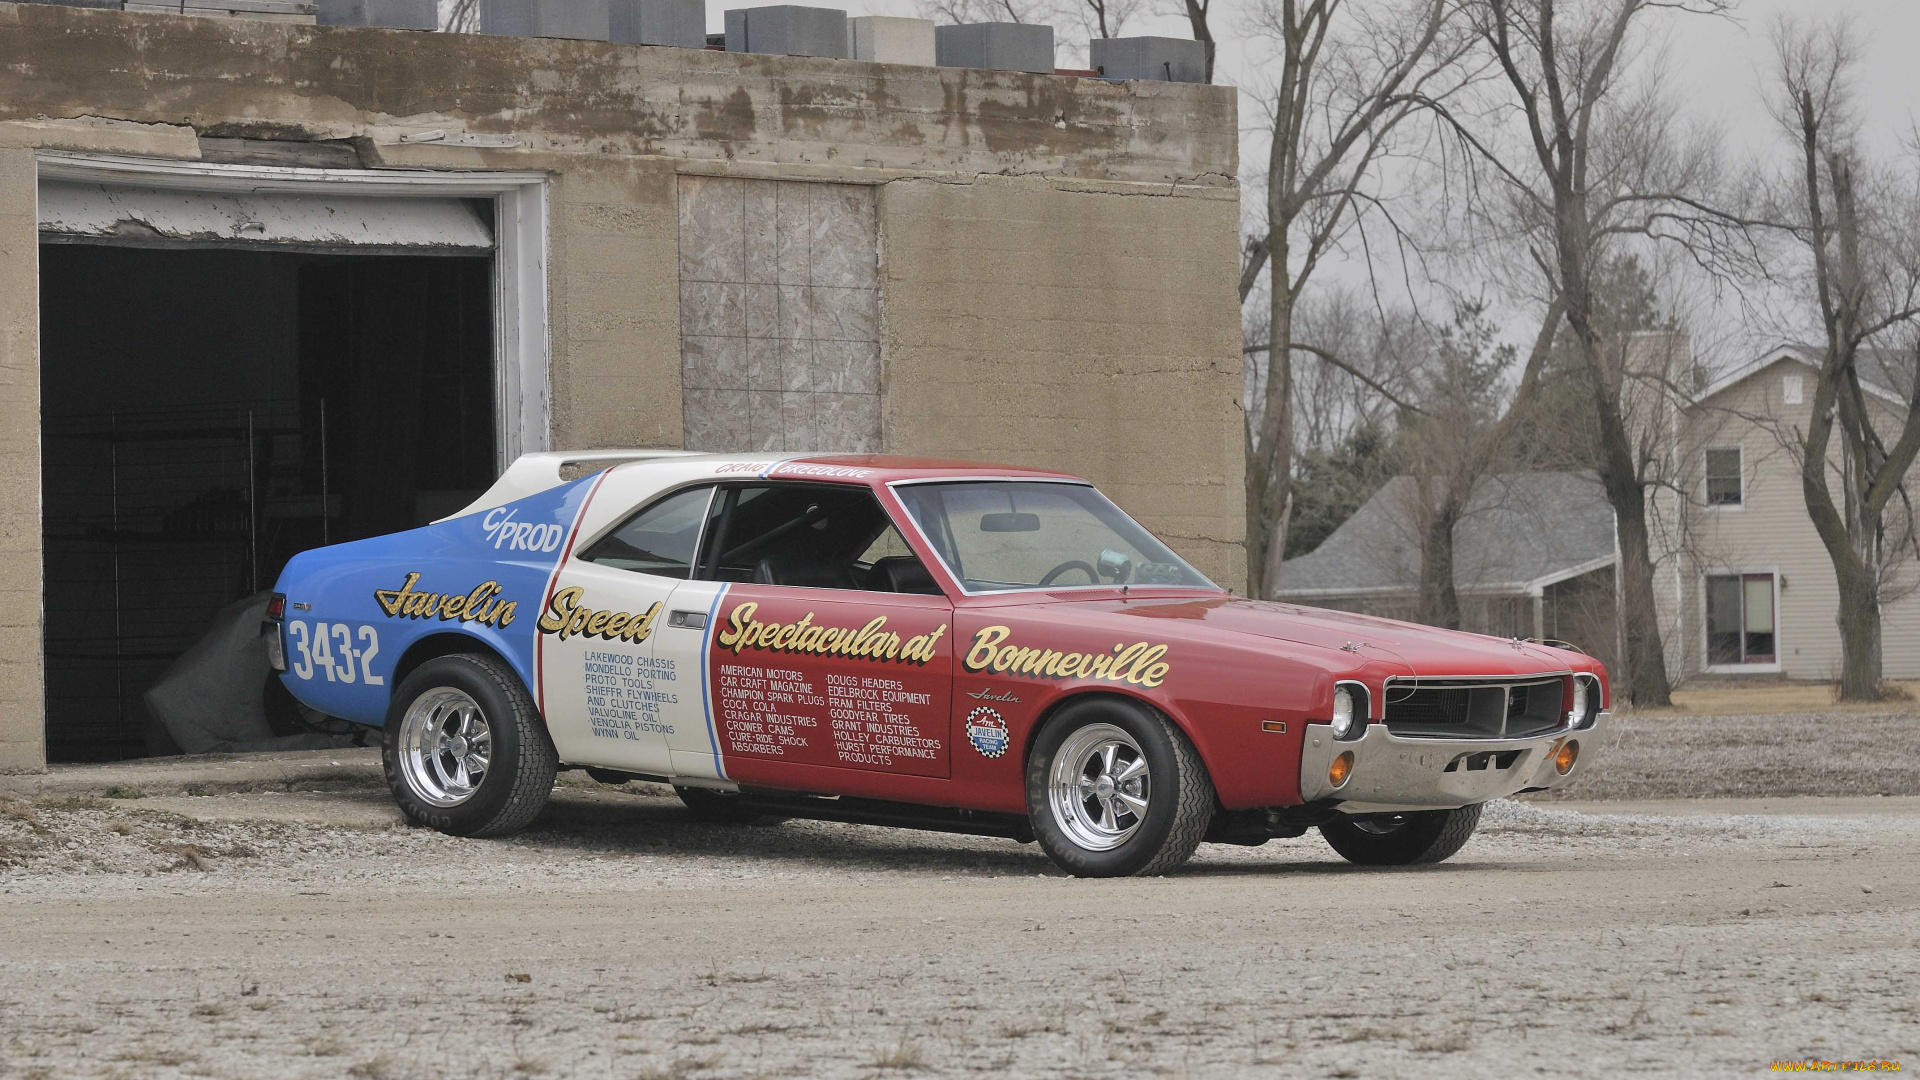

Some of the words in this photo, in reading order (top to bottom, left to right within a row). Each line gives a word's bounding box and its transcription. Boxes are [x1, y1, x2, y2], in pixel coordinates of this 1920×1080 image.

[715, 463, 768, 474] CRAIG
[482, 507, 563, 553] C/PROD
[373, 571, 518, 629] Javelin
[537, 586, 663, 646] Speed
[717, 602, 901, 656] Spectacular
[898, 623, 947, 667] at
[962, 625, 1170, 689] Bonneville
[289, 620, 384, 686] 343-2
[584, 651, 633, 665] LAKEWOOD
[637, 656, 675, 670] CHASSIS
[585, 662, 632, 677] MONDELLO
[637, 668, 676, 681] PORTING
[720, 664, 763, 678] AMERICAN
[766, 668, 803, 682] MOTORS
[585, 673, 617, 686] PROTO
[622, 677, 653, 690] TOOLS
[720, 676, 738, 687] CAR
[740, 677, 767, 690] CRAFT
[770, 680, 814, 694] MAGAZINE
[827, 674, 858, 686] DOUGS
[861, 677, 903, 691] HEADERS
[627, 689, 678, 704] FLYWHEELS
[721, 687, 764, 701] CHAMPION
[767, 691, 794, 704] SPARK
[797, 694, 825, 706] PLUGS
[828, 686, 880, 701] EDELBROCK
[882, 690, 931, 705] EQUIPMENT
[966, 687, 1022, 703] Javelin
[587, 696, 606, 707] AND
[610, 698, 660, 713] CLUTCHES
[722, 699, 748, 710] COCA
[752, 701, 777, 713] COLA
[829, 697, 854, 709] FRAM
[857, 700, 893, 713] FILTERS
[588, 706, 638, 721] VALVOLINE
[641, 712, 657, 723] OIL
[724, 710, 763, 723] CRAGAR
[765, 712, 818, 727] INDUSTRIES
[830, 708, 879, 722] GOODYEAR
[883, 713, 911, 725] TIRES
[590, 717, 632, 730] VENOLIA
[635, 721, 675, 735] PISTONS
[592, 727, 619, 739] WYNN
[623, 730, 640, 741] OIL
[726, 720, 764, 734] CROWER
[767, 724, 795, 736] CAMS
[831, 720, 862, 732] GRANT
[866, 722, 920, 737] INDUSTRIES
[974, 727, 1002, 738] JAVELIN
[728, 731, 775, 745] CURE-RIDE
[778, 735, 809, 747] SHOCK
[833, 730, 870, 743] HOLLEY
[875, 734, 942, 750] CARBURETORS
[979, 738, 998, 746] RACING
[731, 741, 784, 755] ABSORBERS
[835, 741, 866, 753] HURST
[869, 744, 937, 760] PERFORMANCE
[838, 751, 892, 766] PRODUCTS
